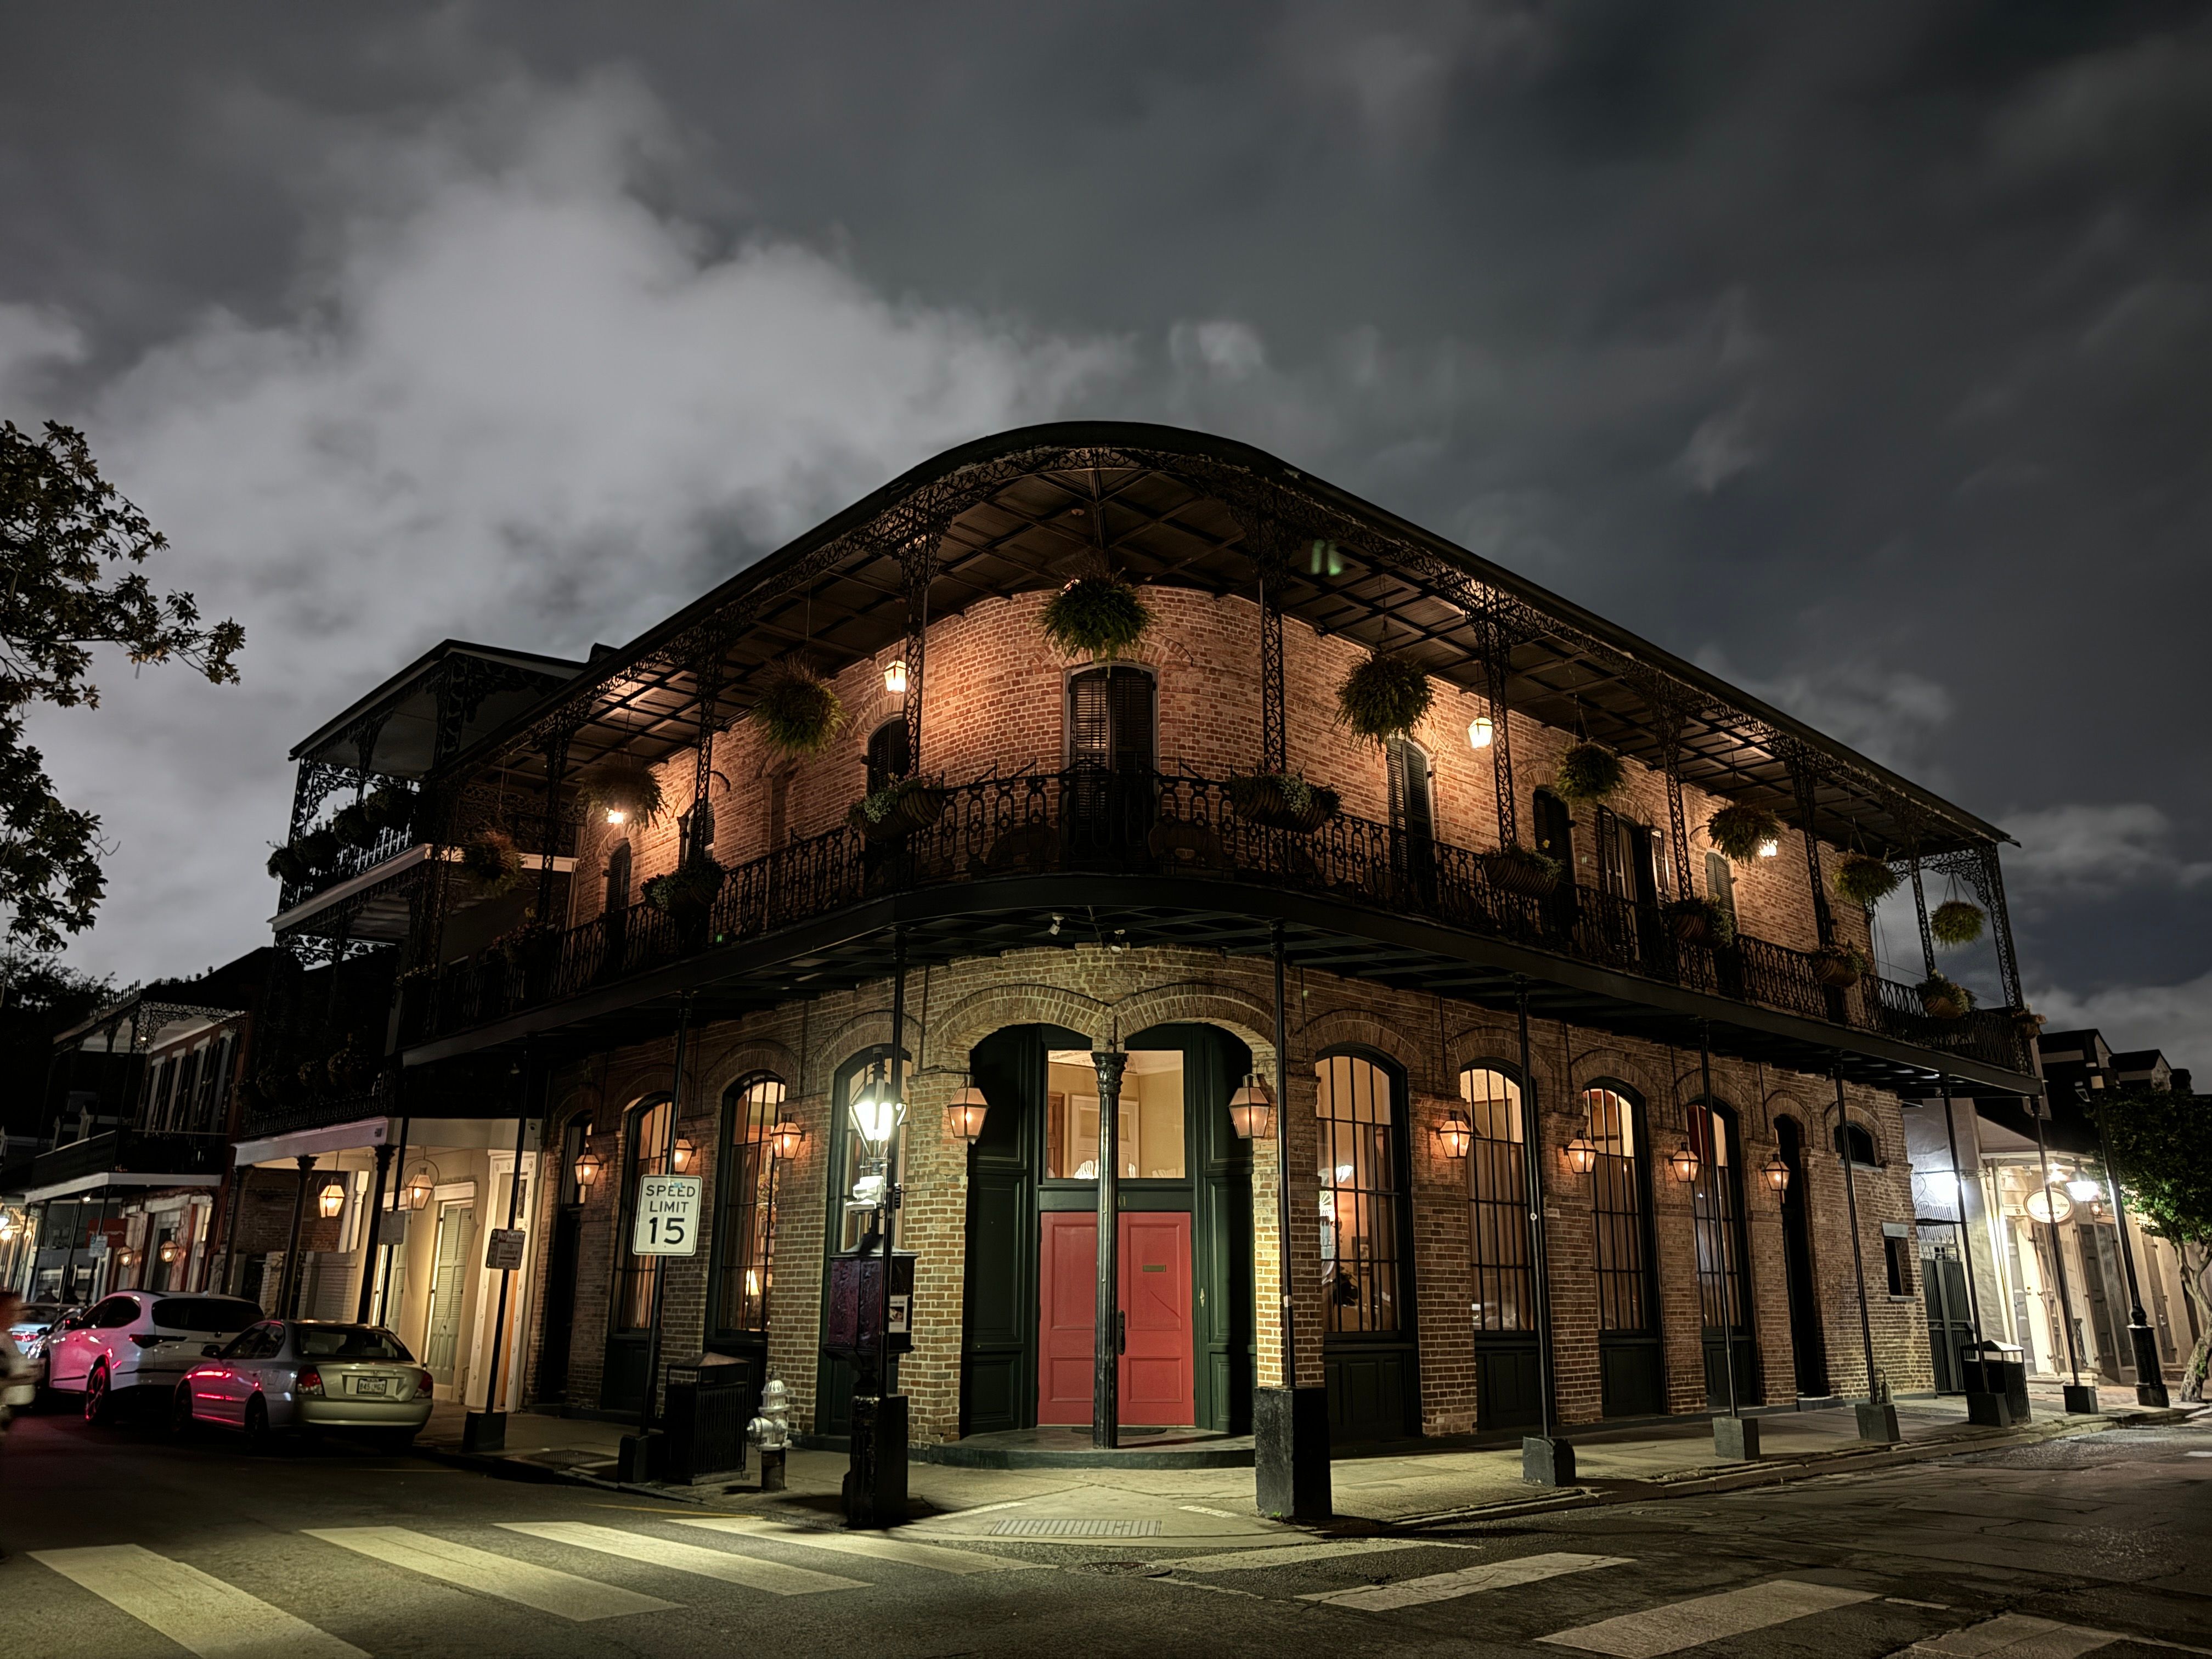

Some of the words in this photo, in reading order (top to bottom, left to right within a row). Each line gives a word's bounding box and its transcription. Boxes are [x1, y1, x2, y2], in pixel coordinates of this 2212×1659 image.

[646, 1185, 696, 1197] SPEED
[649, 1201, 689, 1213] LIMIT
[649, 1217, 685, 1245] 15
